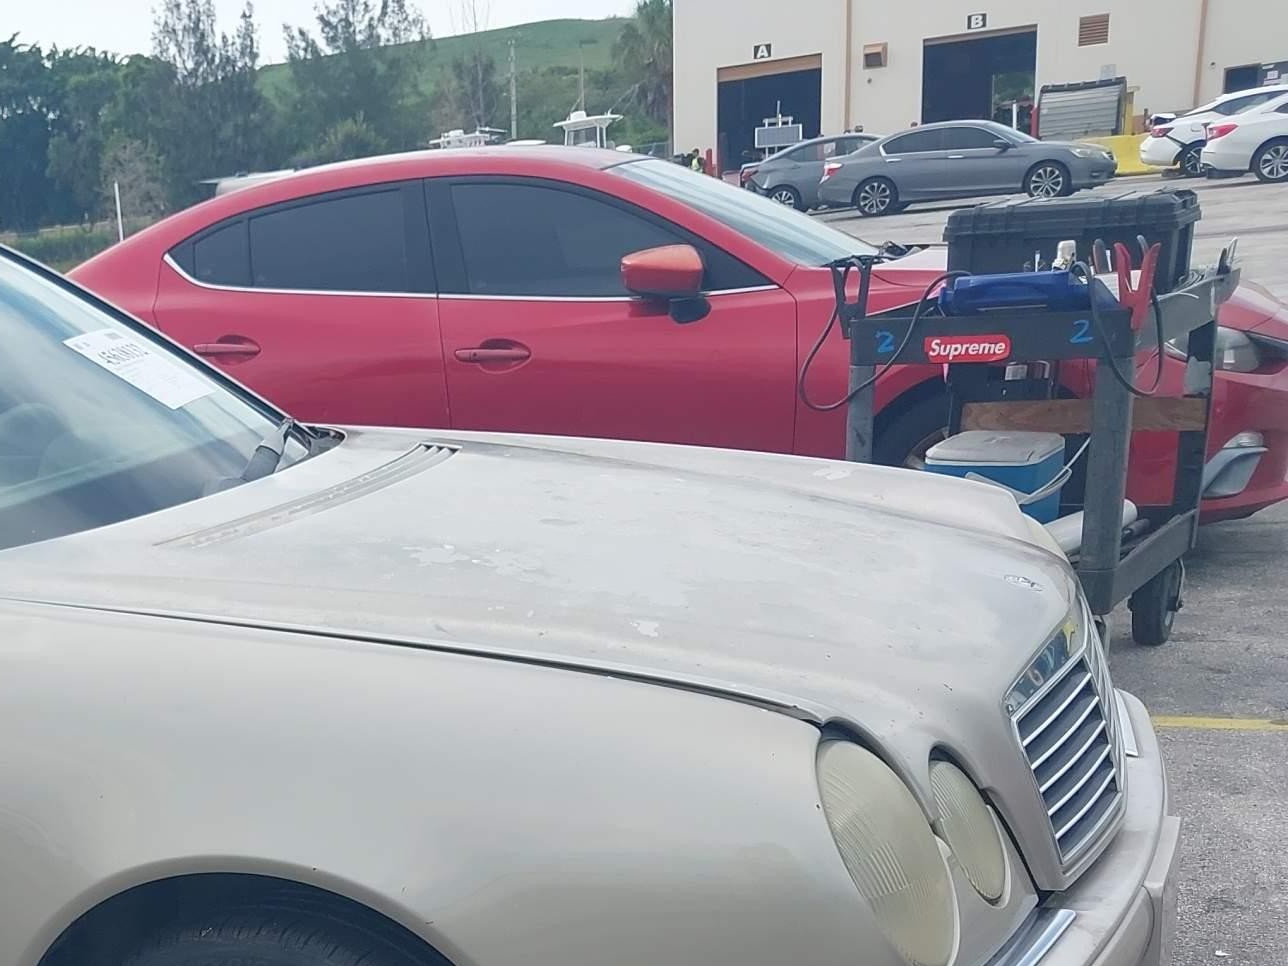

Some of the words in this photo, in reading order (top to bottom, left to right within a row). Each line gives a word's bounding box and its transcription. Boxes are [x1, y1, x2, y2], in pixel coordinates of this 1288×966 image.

[970, 15, 983, 28] B
[756, 45, 769, 58] A
[875, 330, 895, 353] 2
[1070, 320, 1093, 343] 2
[928, 339, 1006, 361] Supreme
